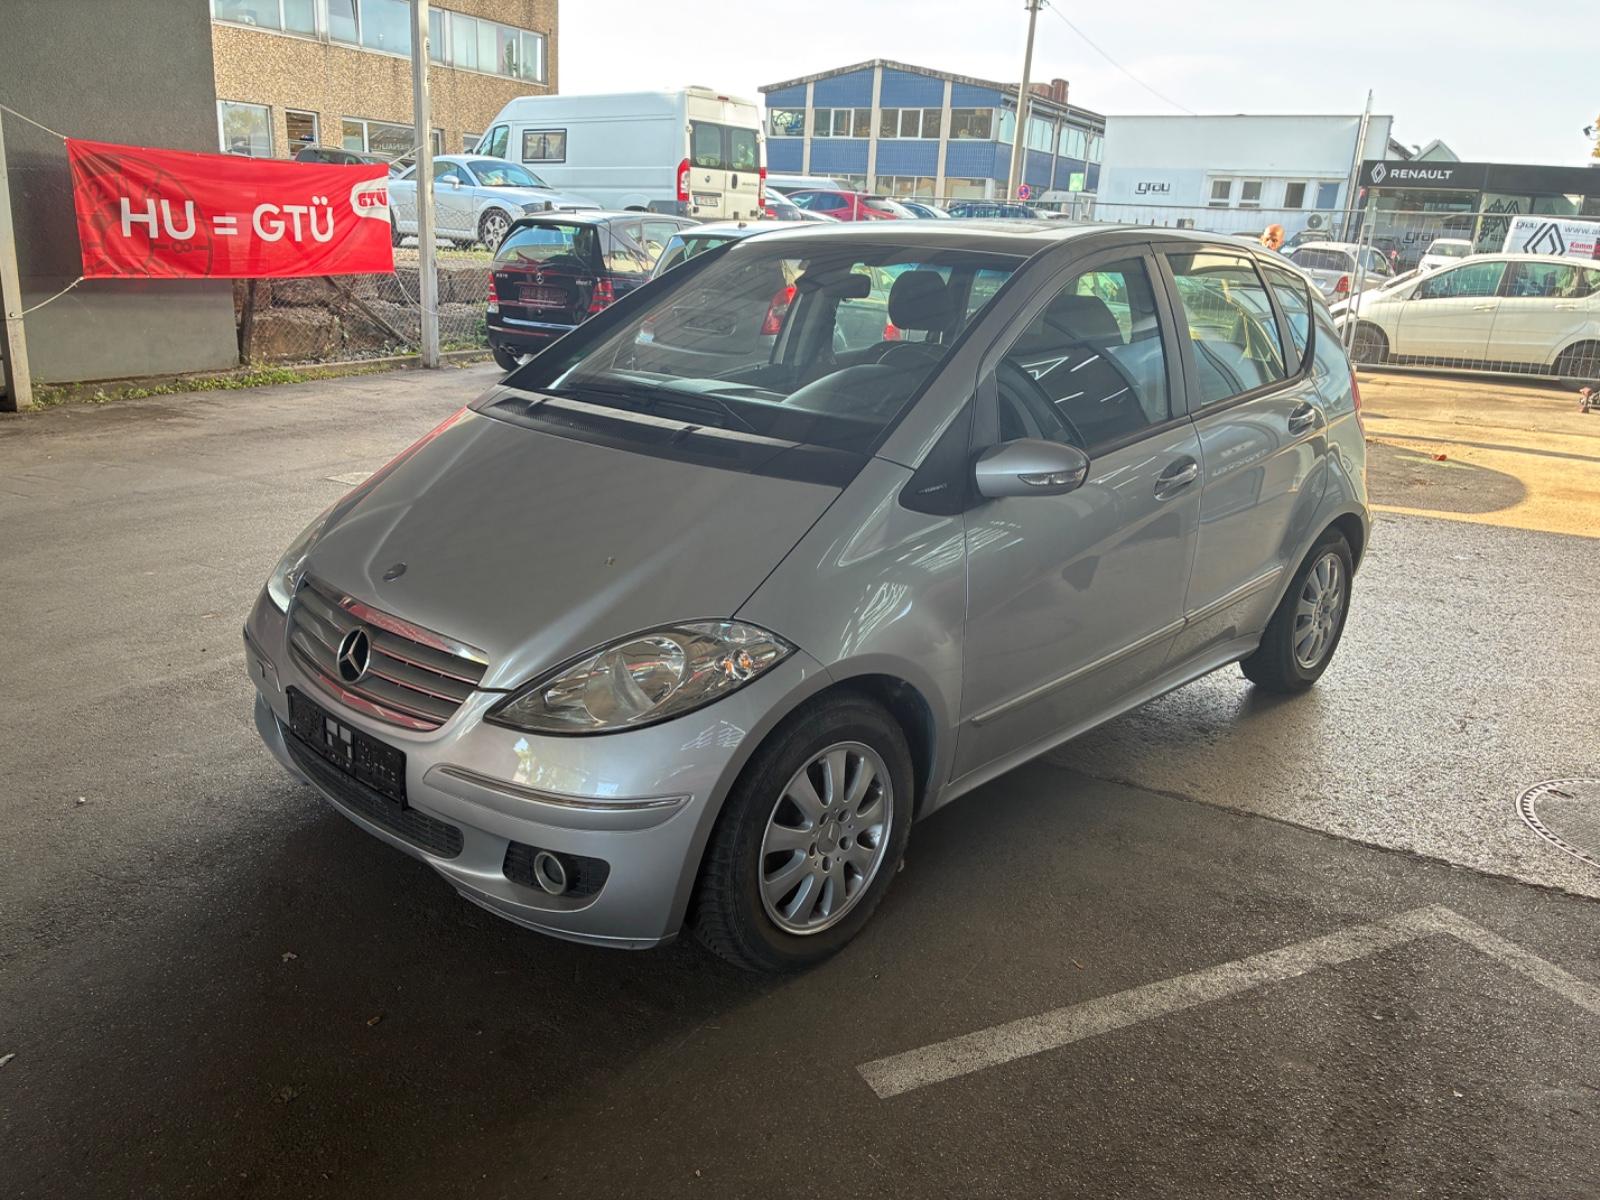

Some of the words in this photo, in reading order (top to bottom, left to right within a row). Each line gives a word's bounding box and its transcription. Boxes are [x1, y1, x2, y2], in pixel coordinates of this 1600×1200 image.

[1390, 168, 1452, 180] RENAULT
[1135, 182, 1170, 194] grau
[357, 187, 387, 207] GTÜ
[120, 197, 196, 240] HU
[212, 215, 238, 235] =
[252, 195, 334, 242] GTÜ
